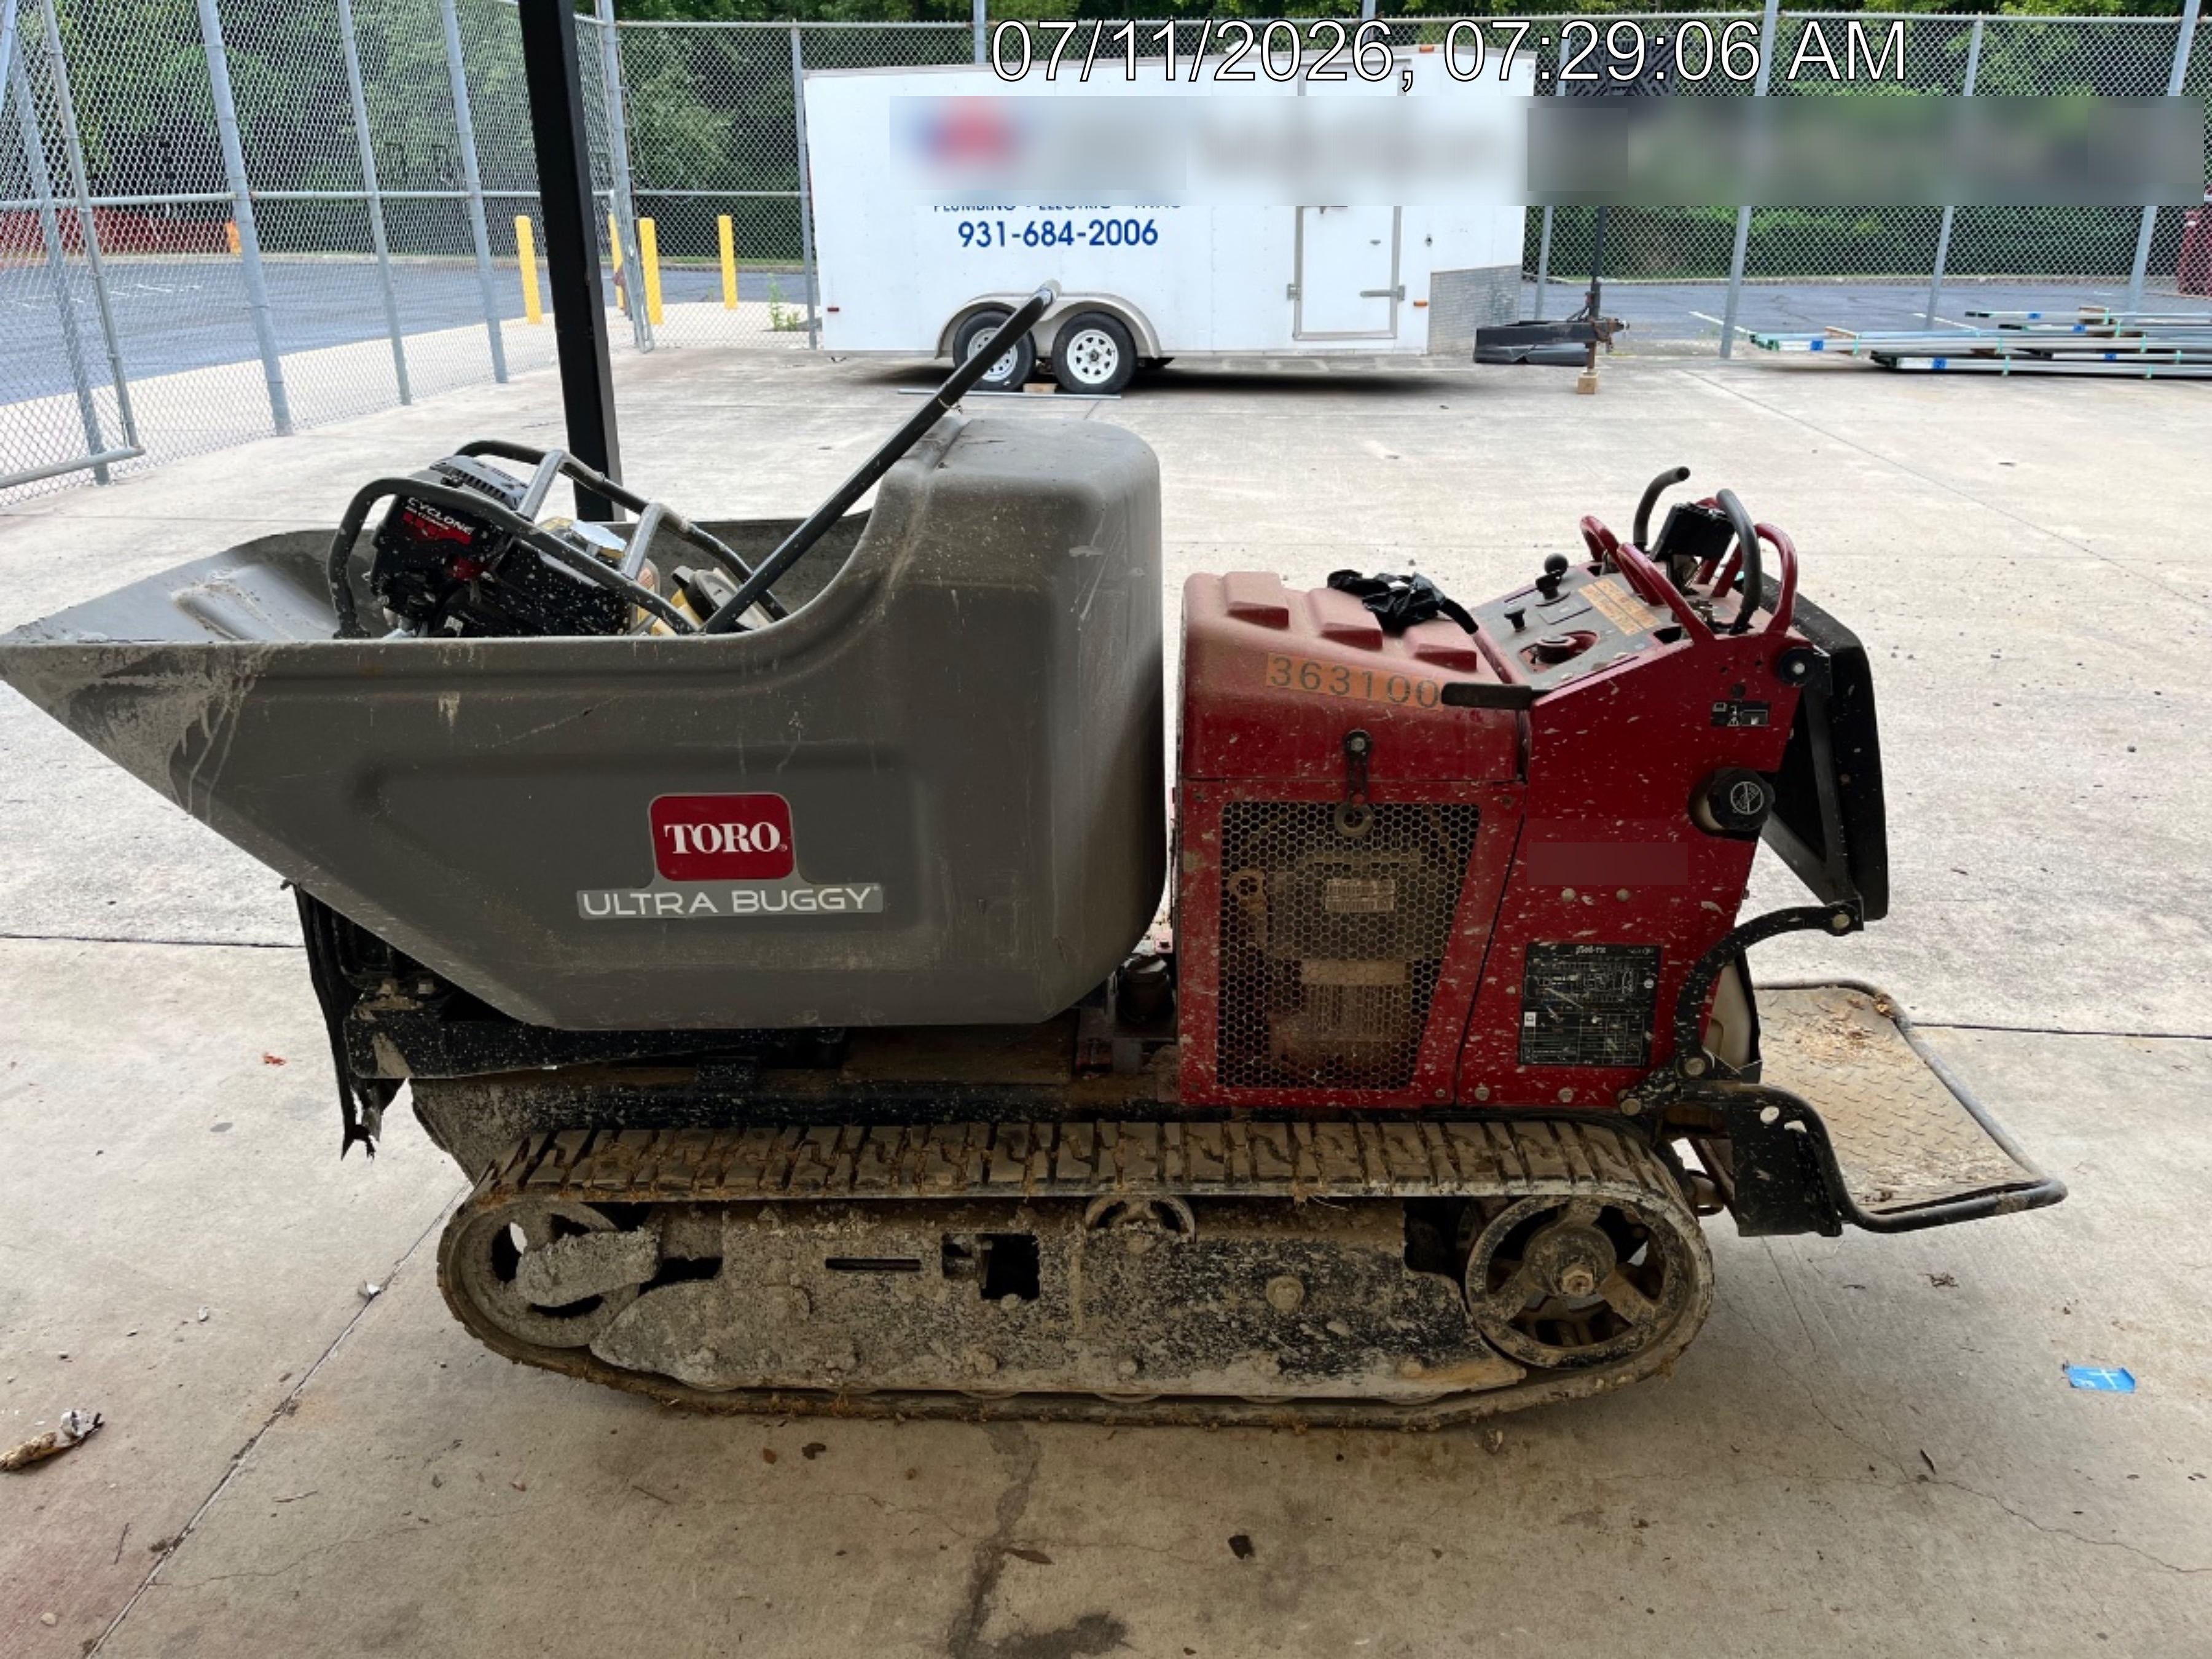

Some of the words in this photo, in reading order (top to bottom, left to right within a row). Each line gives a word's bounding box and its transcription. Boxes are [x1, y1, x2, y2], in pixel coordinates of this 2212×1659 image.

[957, 218, 1159, 248] 931-684-2006
[1269, 656, 1440, 708] 363100
[663, 821, 781, 854] TORO
[582, 891, 719, 916] ULTRA
[731, 887, 873, 914] BUGGY
